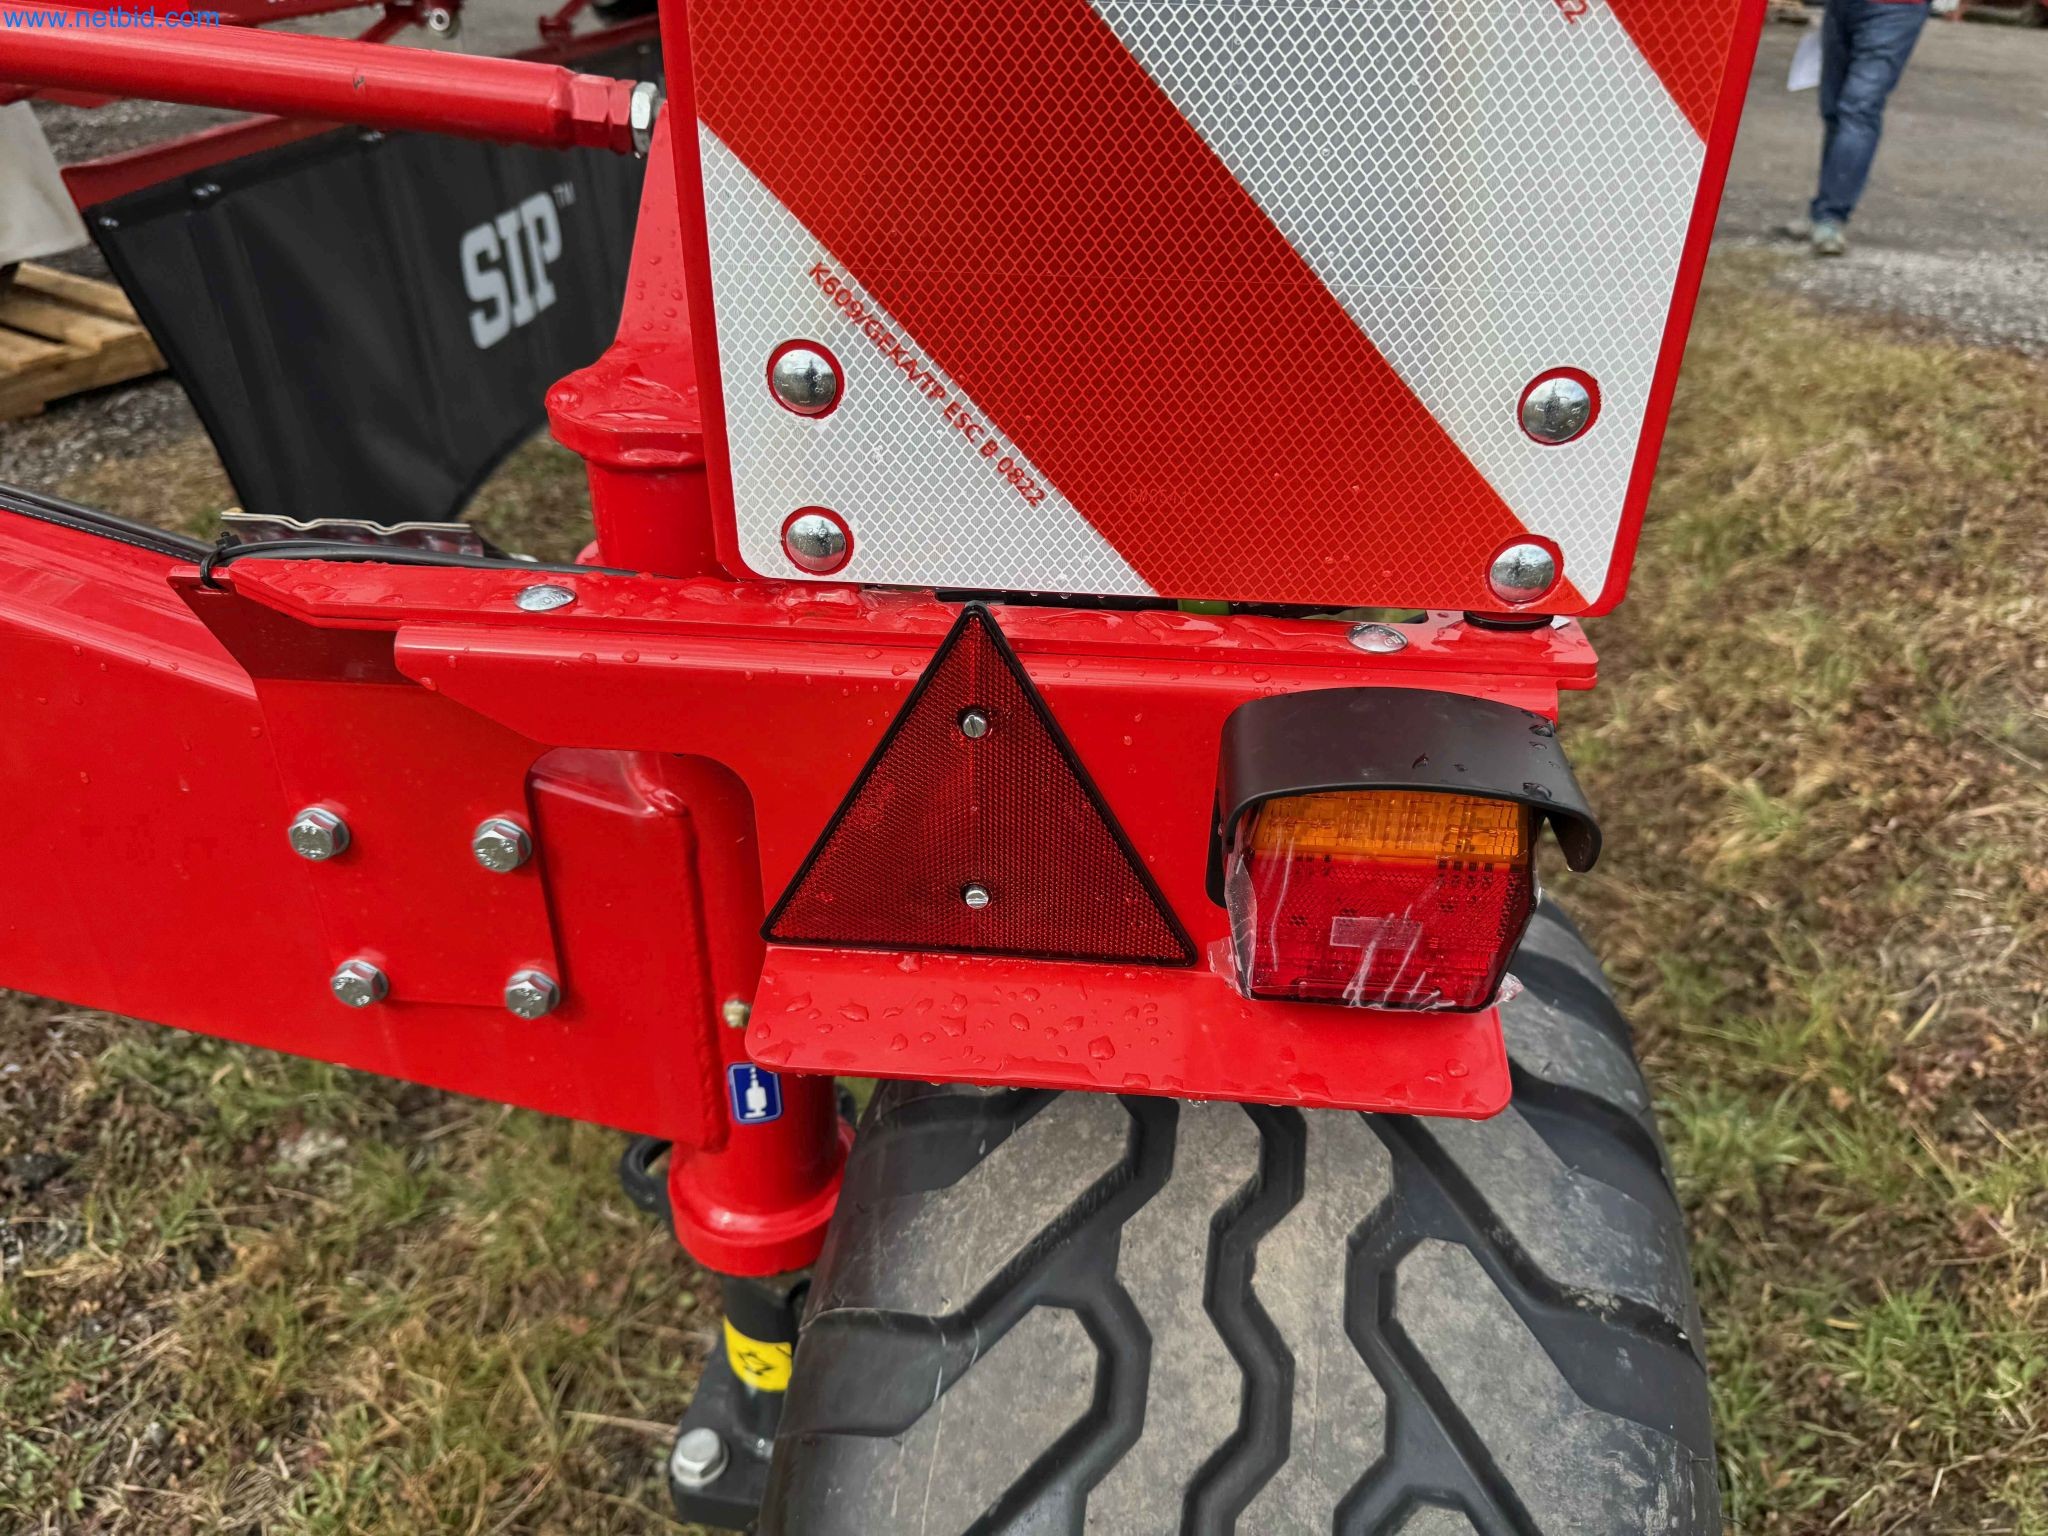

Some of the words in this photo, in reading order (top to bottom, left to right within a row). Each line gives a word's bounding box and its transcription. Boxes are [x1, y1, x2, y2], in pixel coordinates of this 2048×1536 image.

[460, 190, 562, 350] SIP
[943, 401, 984, 443] ESC
[980, 439, 999, 459] B
[996, 456, 1046, 508] 0822
